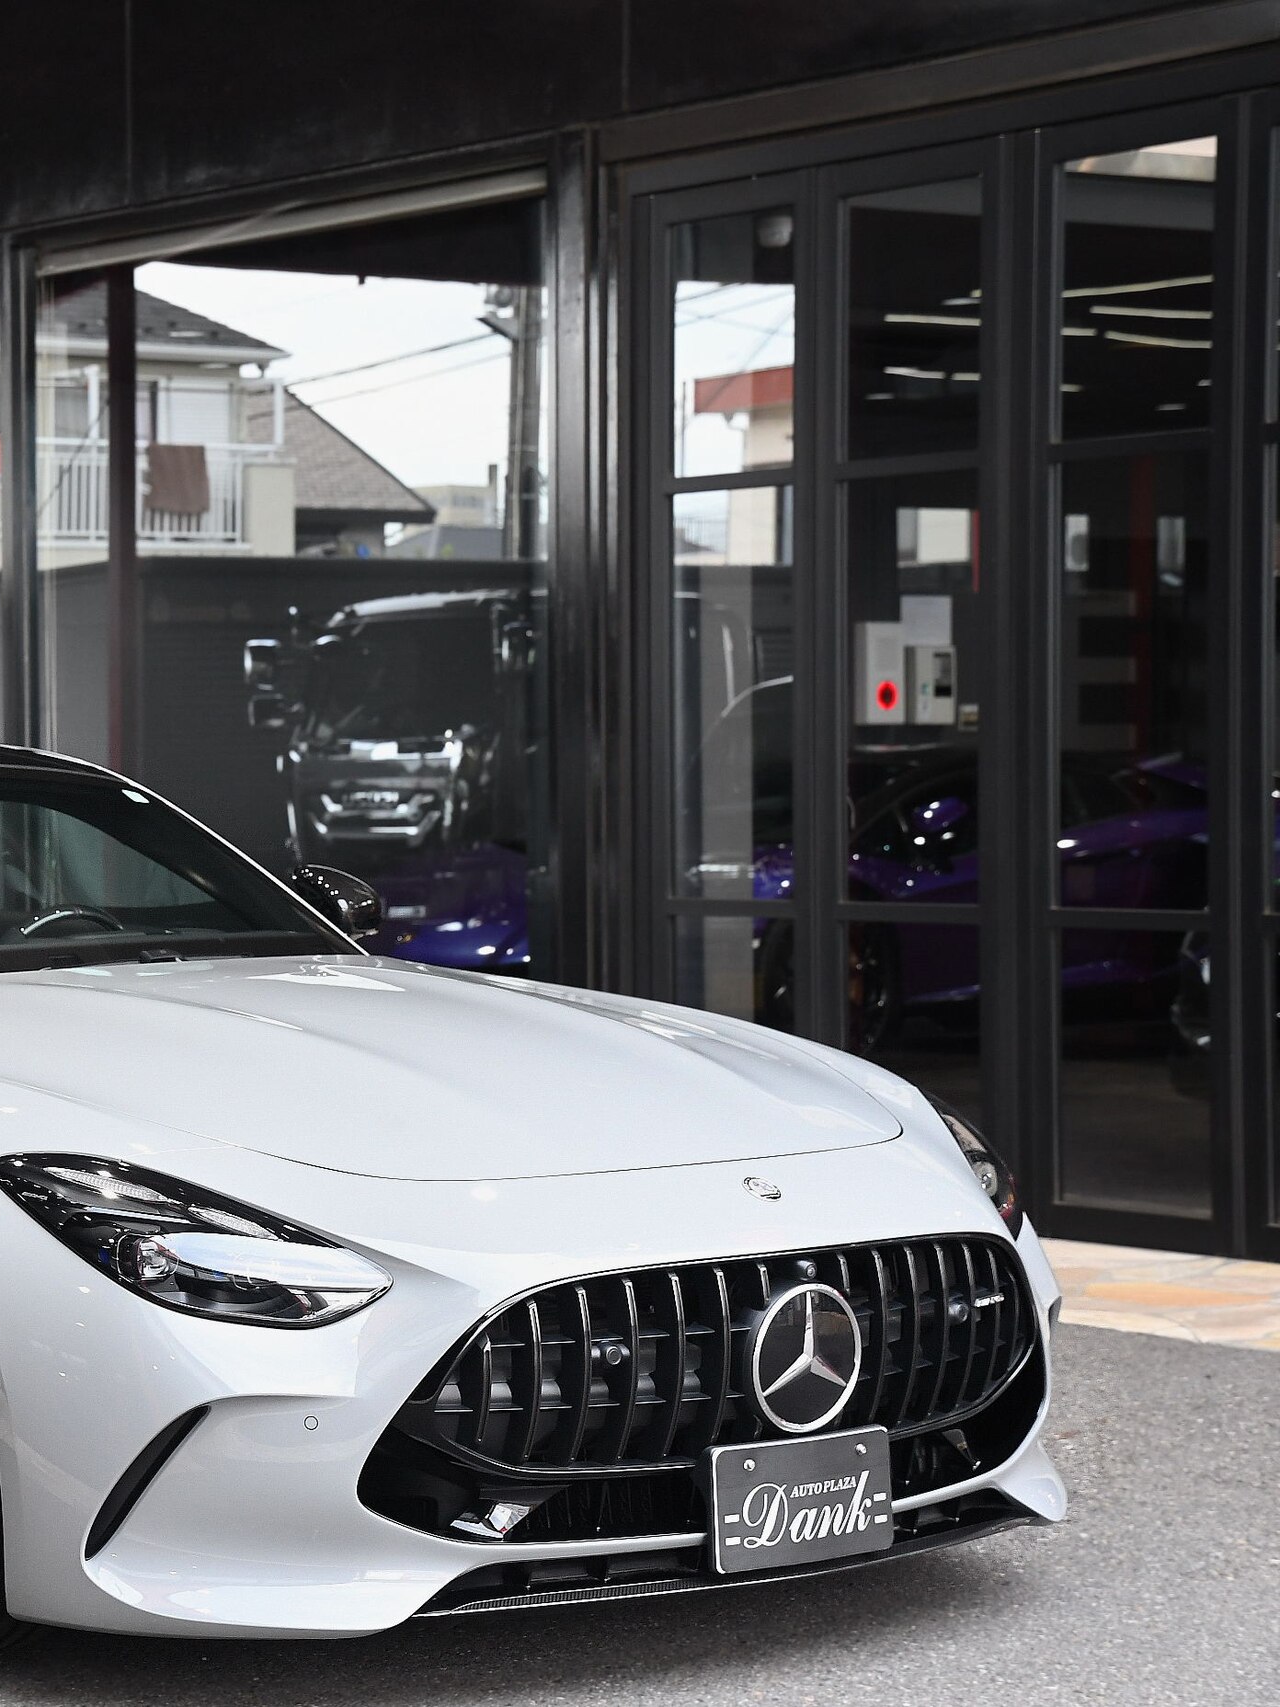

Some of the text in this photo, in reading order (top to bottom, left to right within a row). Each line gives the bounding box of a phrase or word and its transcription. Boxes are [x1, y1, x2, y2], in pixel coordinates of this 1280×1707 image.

[742, 1470, 872, 1549] Dank
[789, 1476, 857, 1498] AUTO PLAZA
